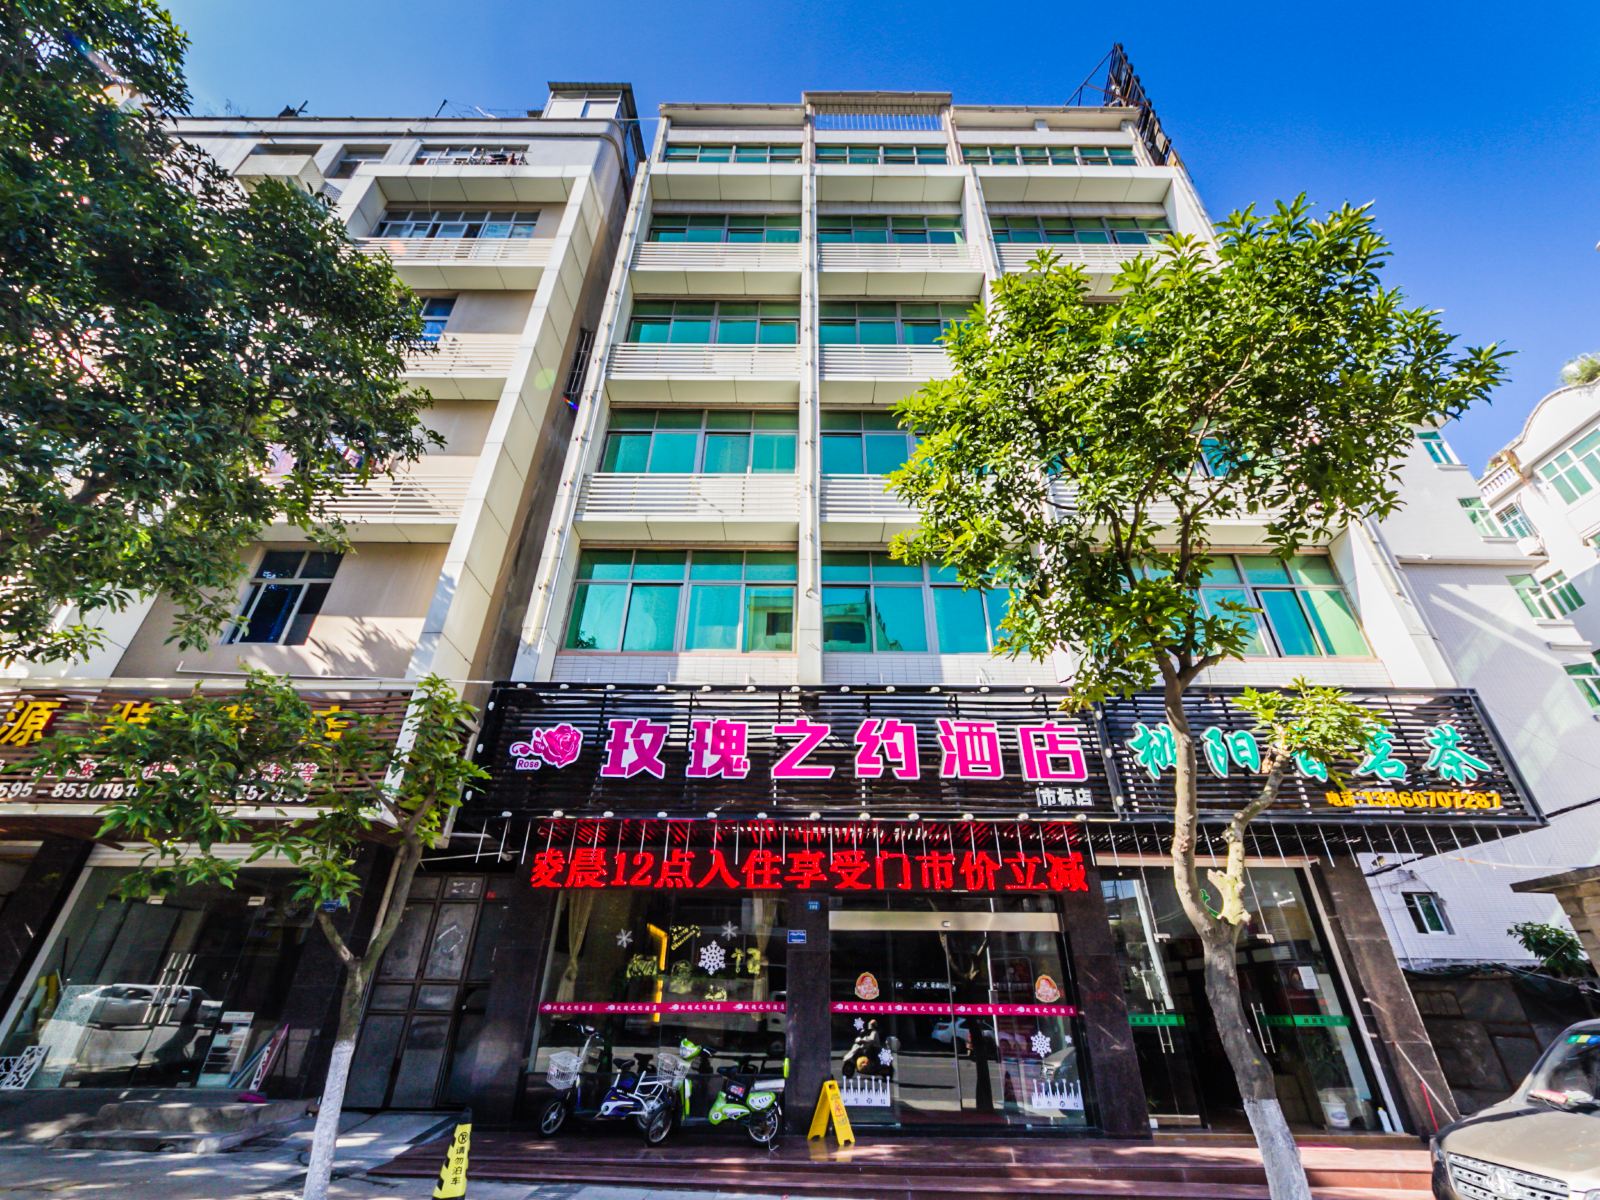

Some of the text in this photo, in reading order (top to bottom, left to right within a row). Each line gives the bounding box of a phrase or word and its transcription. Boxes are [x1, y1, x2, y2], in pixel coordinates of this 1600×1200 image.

[516, 758, 541, 770] Rose
[600, 718, 1088, 782] 玫瑰之约酒店
